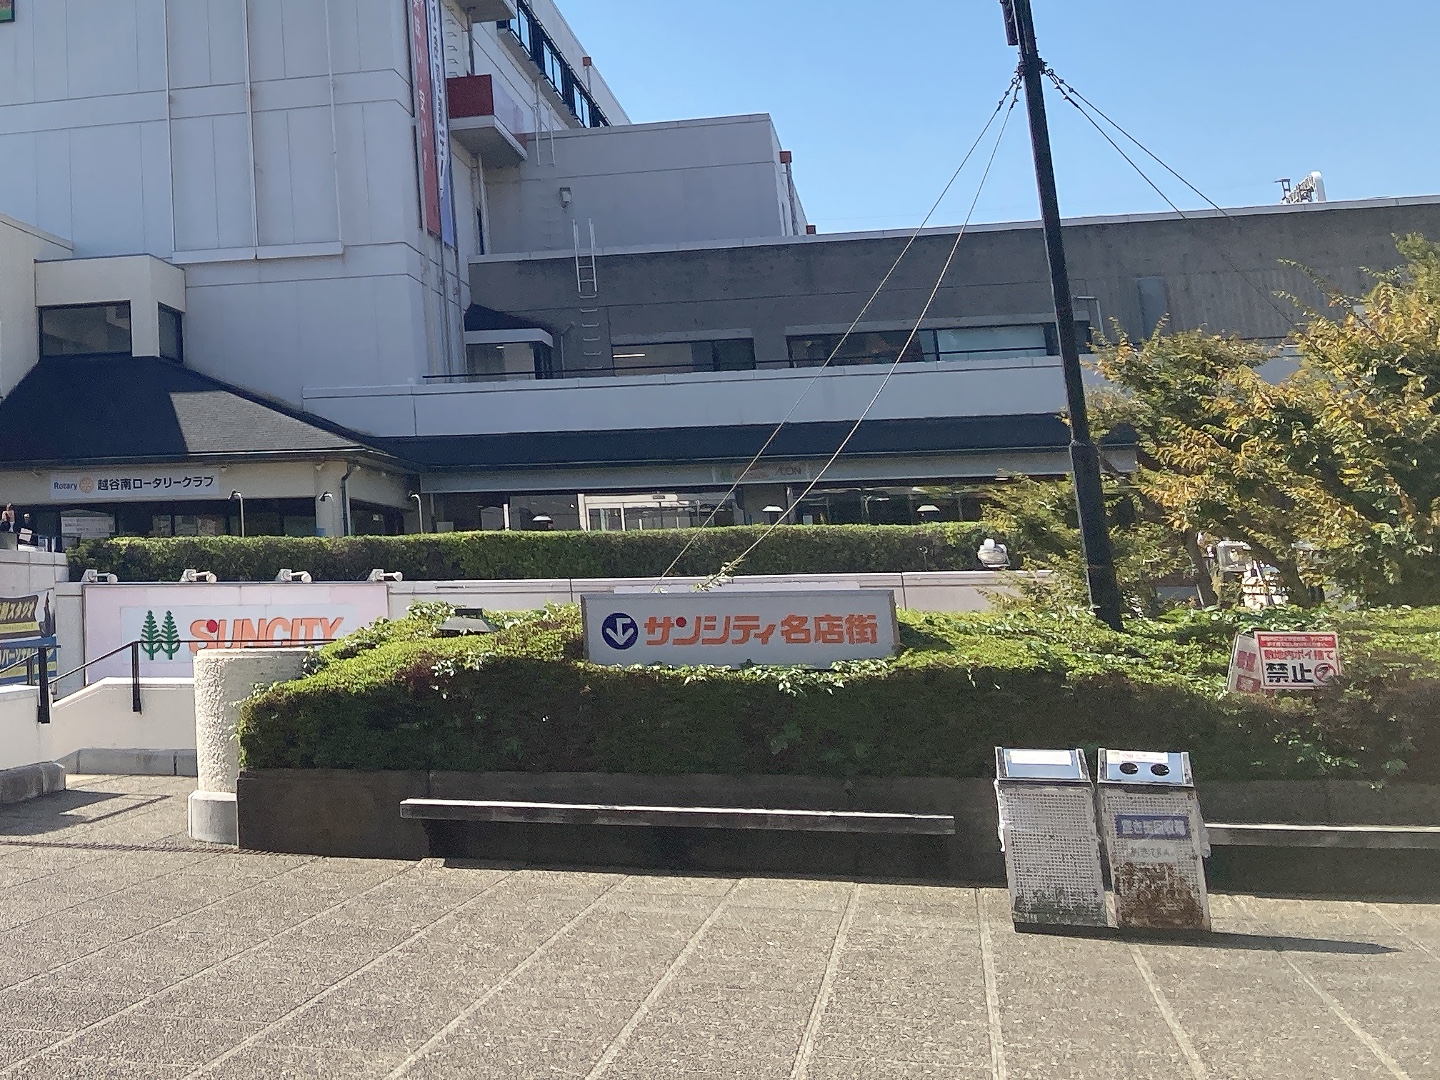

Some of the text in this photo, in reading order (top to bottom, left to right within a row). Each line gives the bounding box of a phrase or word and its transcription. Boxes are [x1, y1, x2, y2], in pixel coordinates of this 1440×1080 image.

[53, 475, 214, 491] Rotary 越谷南ロータリークラブ
[189, 617, 345, 655] SUNCITY
[643, 613, 879, 646] サンシティ名店街
[1265, 662, 1314, 683] 禁止
